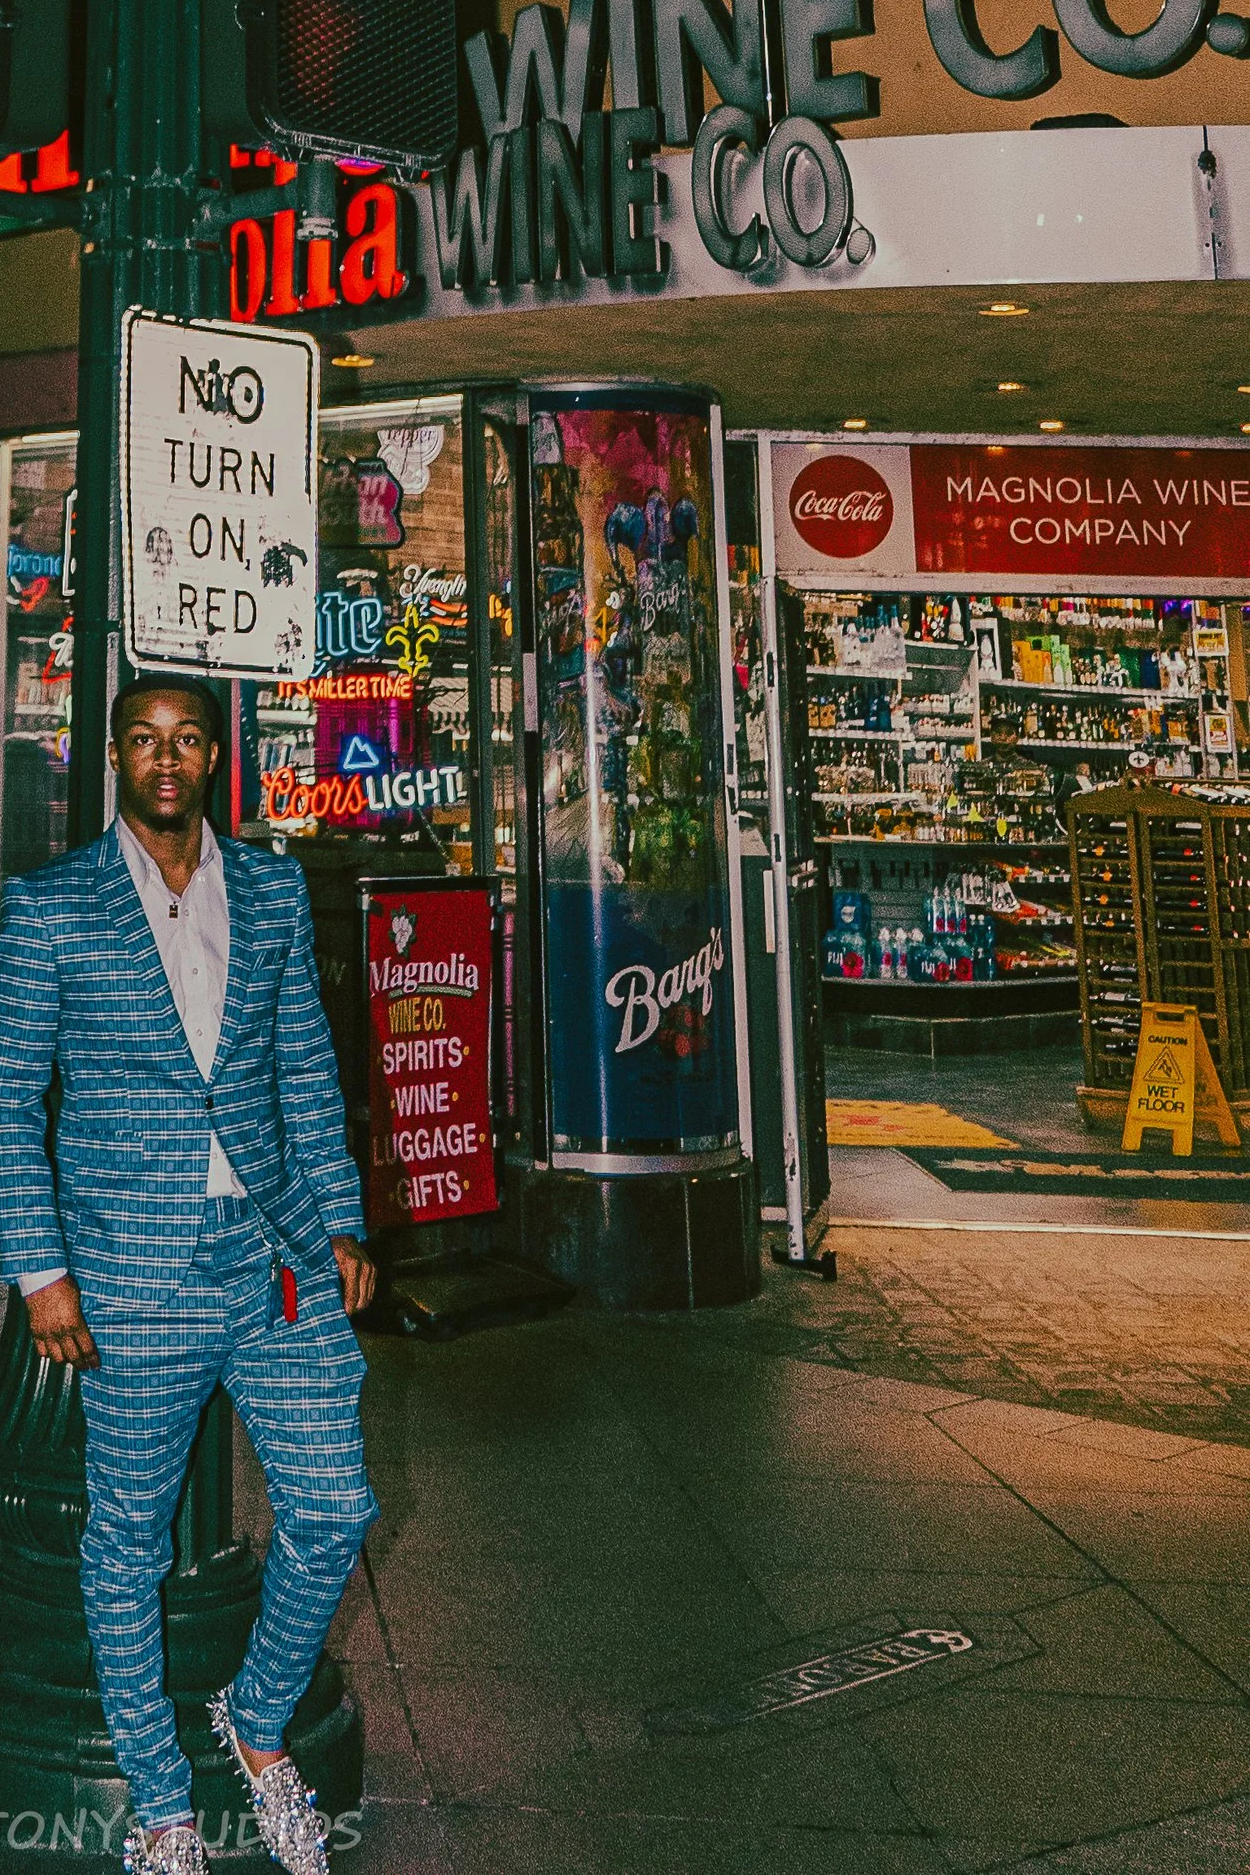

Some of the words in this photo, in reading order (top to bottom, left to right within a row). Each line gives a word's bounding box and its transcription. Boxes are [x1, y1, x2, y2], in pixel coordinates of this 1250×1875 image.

[430, 106, 669, 291] WINE
[691, 104, 878, 272] CO.
[178, 355, 264, 424] NO
[164, 438, 275, 497] TURN
[794, 489, 887, 522] Coca-Cola
[946, 476, 1142, 505] MAGNOLIA
[1153, 479, 1250, 507] WINE
[190, 513, 246, 564] ON
[1009, 517, 1192, 547] COMPANY
[178, 583, 257, 635] RED
[316, 589, 384, 657] ite
[309, 676, 369, 700] MILLER
[370, 675, 413, 700] TIME
[262, 766, 368, 822] Coors
[366, 766, 459, 811] LIGHT
[369, 953, 480, 998] Magnolia
[605, 927, 724, 1053] Barq's
[389, 997, 421, 1034] WINE
[422, 995, 446, 1031] CO.
[383, 1036, 464, 1075] SPIRITS
[1148, 1034, 1188, 1046] CAUTION
[394, 1082, 450, 1118] WINE
[1138, 1097, 1186, 1114] FLOOR
[1147, 1085, 1179, 1098] WET
[373, 1122, 478, 1166] LUGGAGE
[396, 1170, 462, 1210] GIFTS
